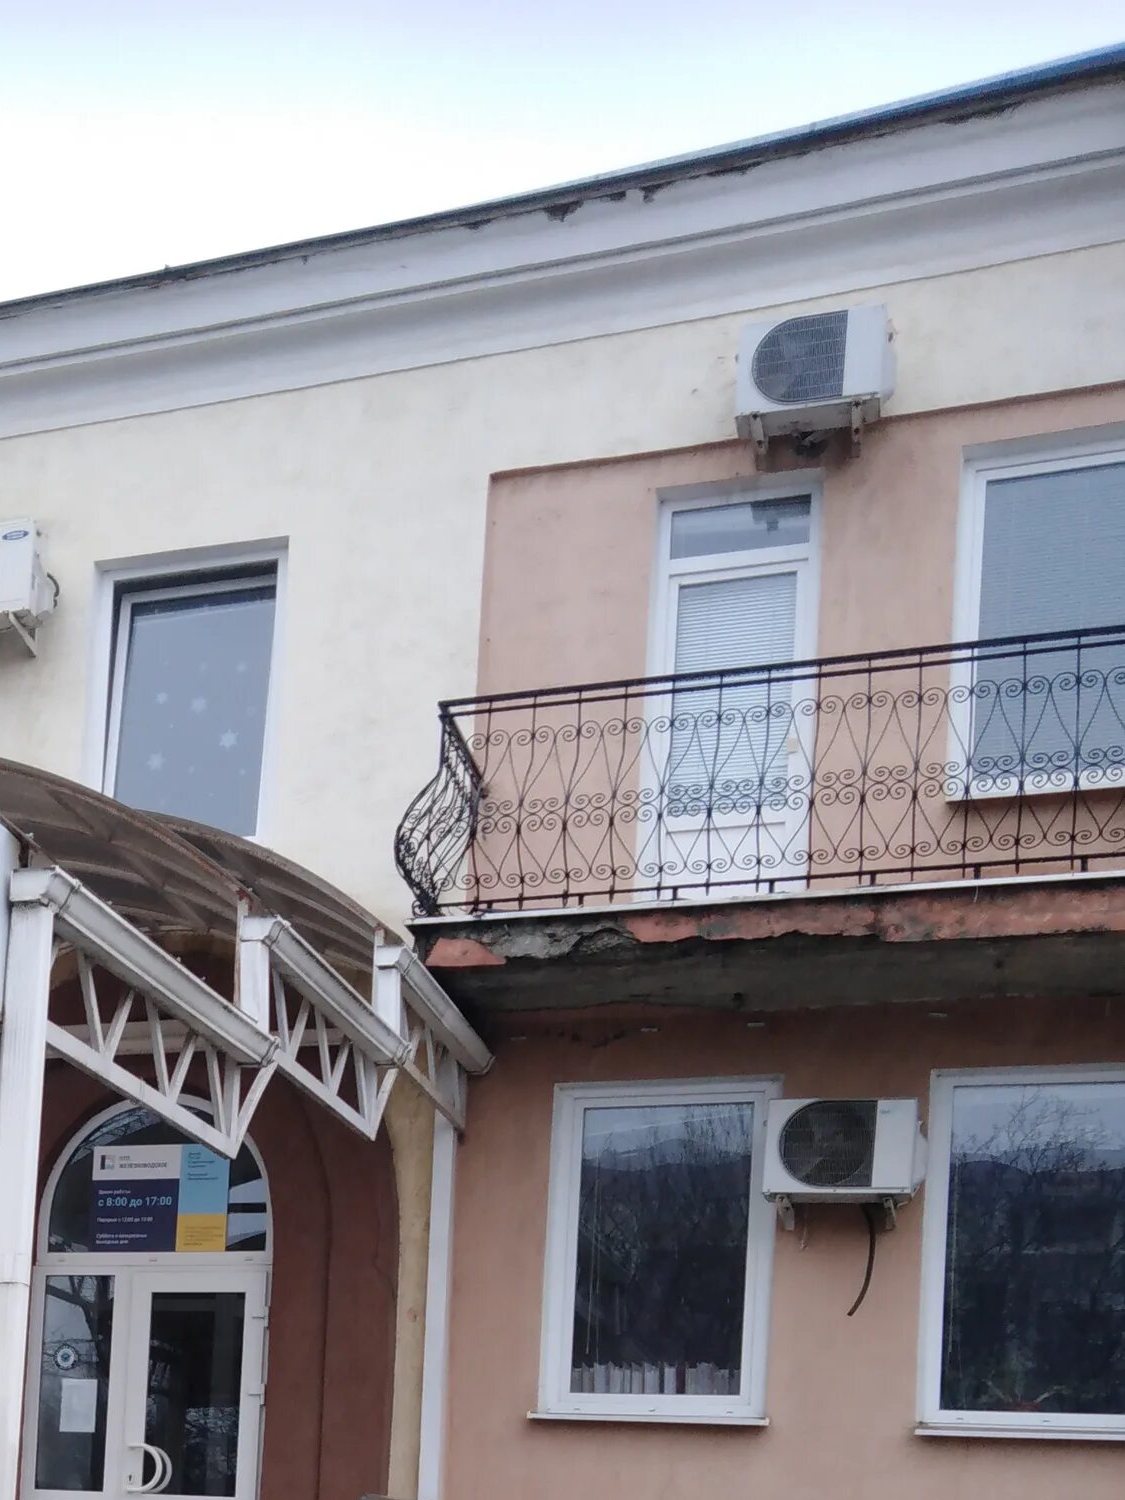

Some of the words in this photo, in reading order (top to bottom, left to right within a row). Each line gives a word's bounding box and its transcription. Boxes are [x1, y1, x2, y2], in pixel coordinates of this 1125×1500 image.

[98, 1199, 104, 1207] с
[106, 1197, 128, 1207] 8:00
[129, 1198, 143, 1208] до
[145, 1196, 172, 1206] 17:00
